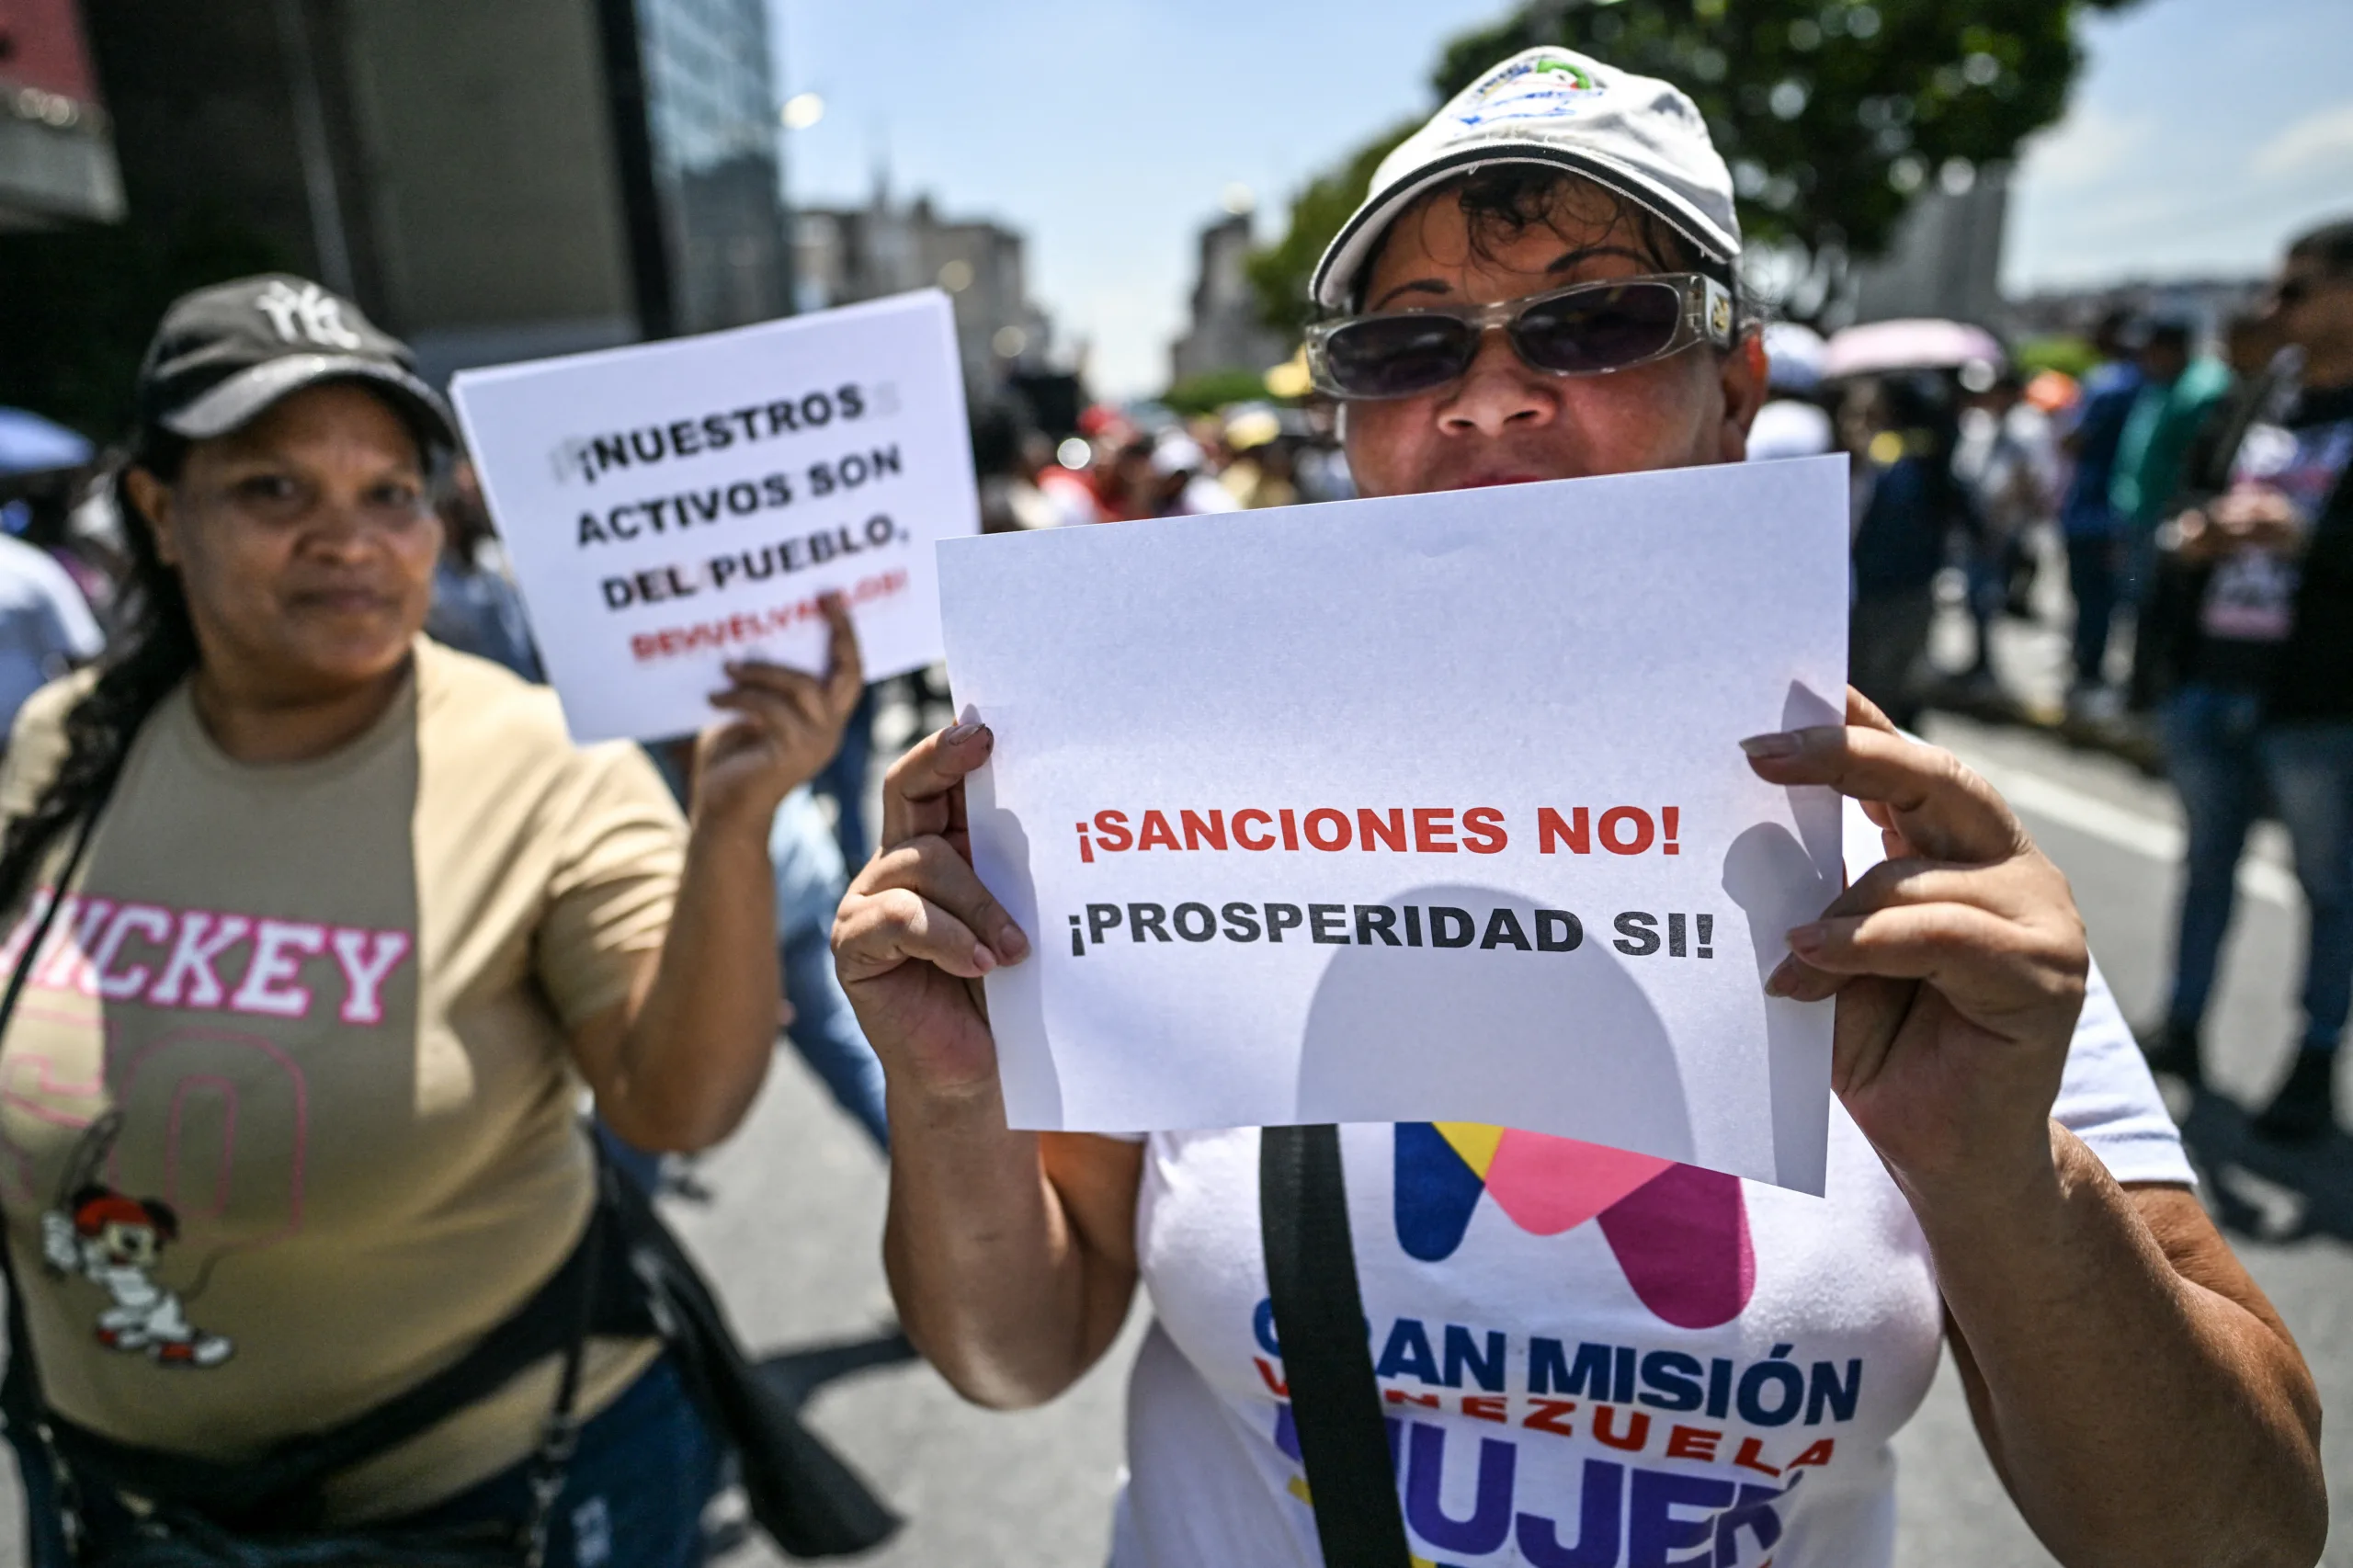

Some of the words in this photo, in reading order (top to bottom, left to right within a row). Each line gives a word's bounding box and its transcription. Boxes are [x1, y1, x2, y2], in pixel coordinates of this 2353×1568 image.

[578, 383, 864, 484] ¡NUESTROS
[577, 472, 793, 549] ACTIVOS
[807, 443, 902, 497] SON
[601, 564, 699, 611] DEL
[709, 514, 910, 589] PUEBLO,
[1075, 807, 1509, 864] ¡SANCIONES
[1538, 806, 1681, 856] NO!
[1068, 902, 1585, 957] ¡PROSPERIDAD
[1612, 911, 1715, 960] SI!
[1253, 1297, 1507, 1392] AN
[1527, 1336, 1863, 1427] MISIÓN
[1252, 1356, 1836, 1479] VNEZUELA
